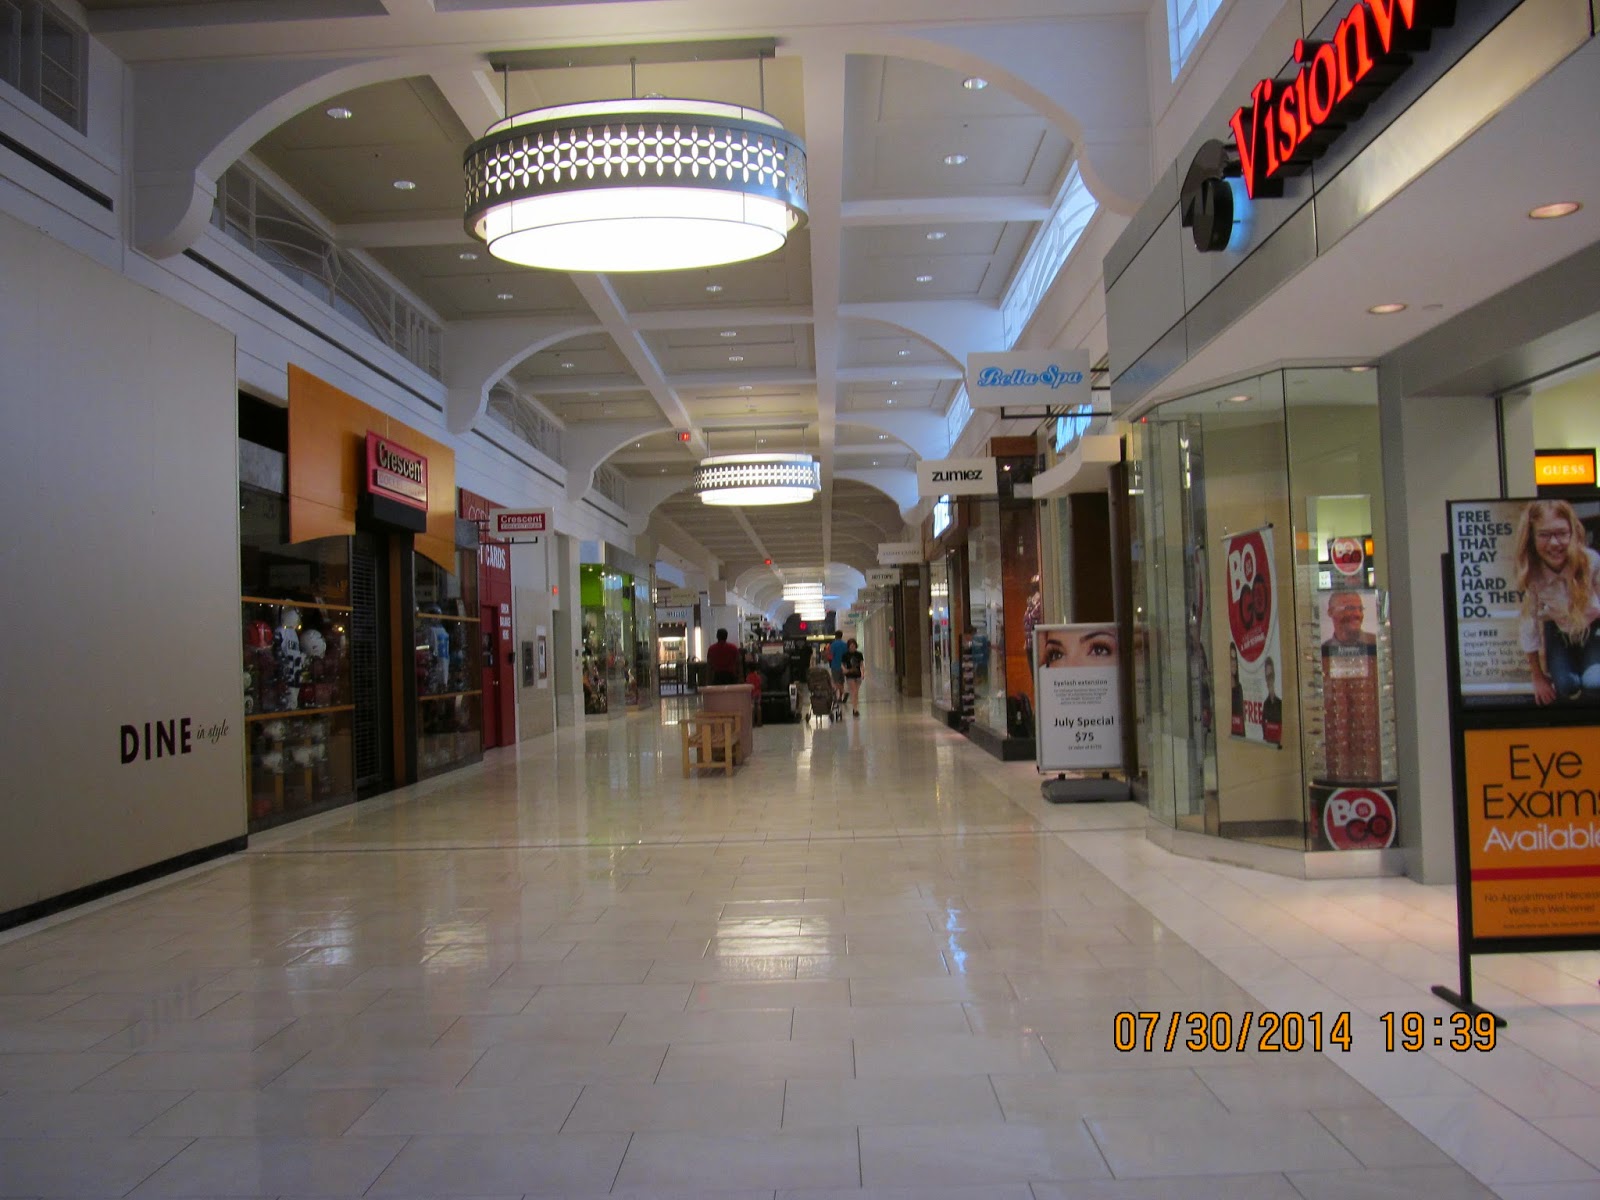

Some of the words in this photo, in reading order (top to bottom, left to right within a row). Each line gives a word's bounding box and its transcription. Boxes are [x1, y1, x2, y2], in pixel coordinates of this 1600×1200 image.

[977, 366, 1038, 388] Bella
[1040, 364, 1083, 389] Spa
[378, 440, 424, 484] Crescent
[1542, 464, 1586, 476] GUESS
[500, 515, 542, 523] Crescent
[1457, 510, 1491, 523] FREE
[1458, 523, 1513, 537] LENSES
[1458, 537, 1498, 550] THAT
[485, 544, 506, 571] CARDS
[1460, 551, 1498, 564] PLAY
[1461, 564, 1482, 577] AS
[1461, 577, 1507, 591] HARD
[1462, 592, 1483, 605] AS
[1488, 590, 1526, 604] THEY
[1463, 605, 1491, 619] DO.
[1478, 629, 1498, 637] FREE
[1243, 700, 1264, 725] FREE
[1054, 716, 1075, 729] July
[1077, 715, 1114, 728] Special
[120, 717, 192, 765] DINE
[196, 724, 205, 740] in
[207, 718, 229, 744] style
[1075, 731, 1094, 743] $75
[1509, 744, 1583, 788] Eye
[1483, 783, 1600, 820] Exam
